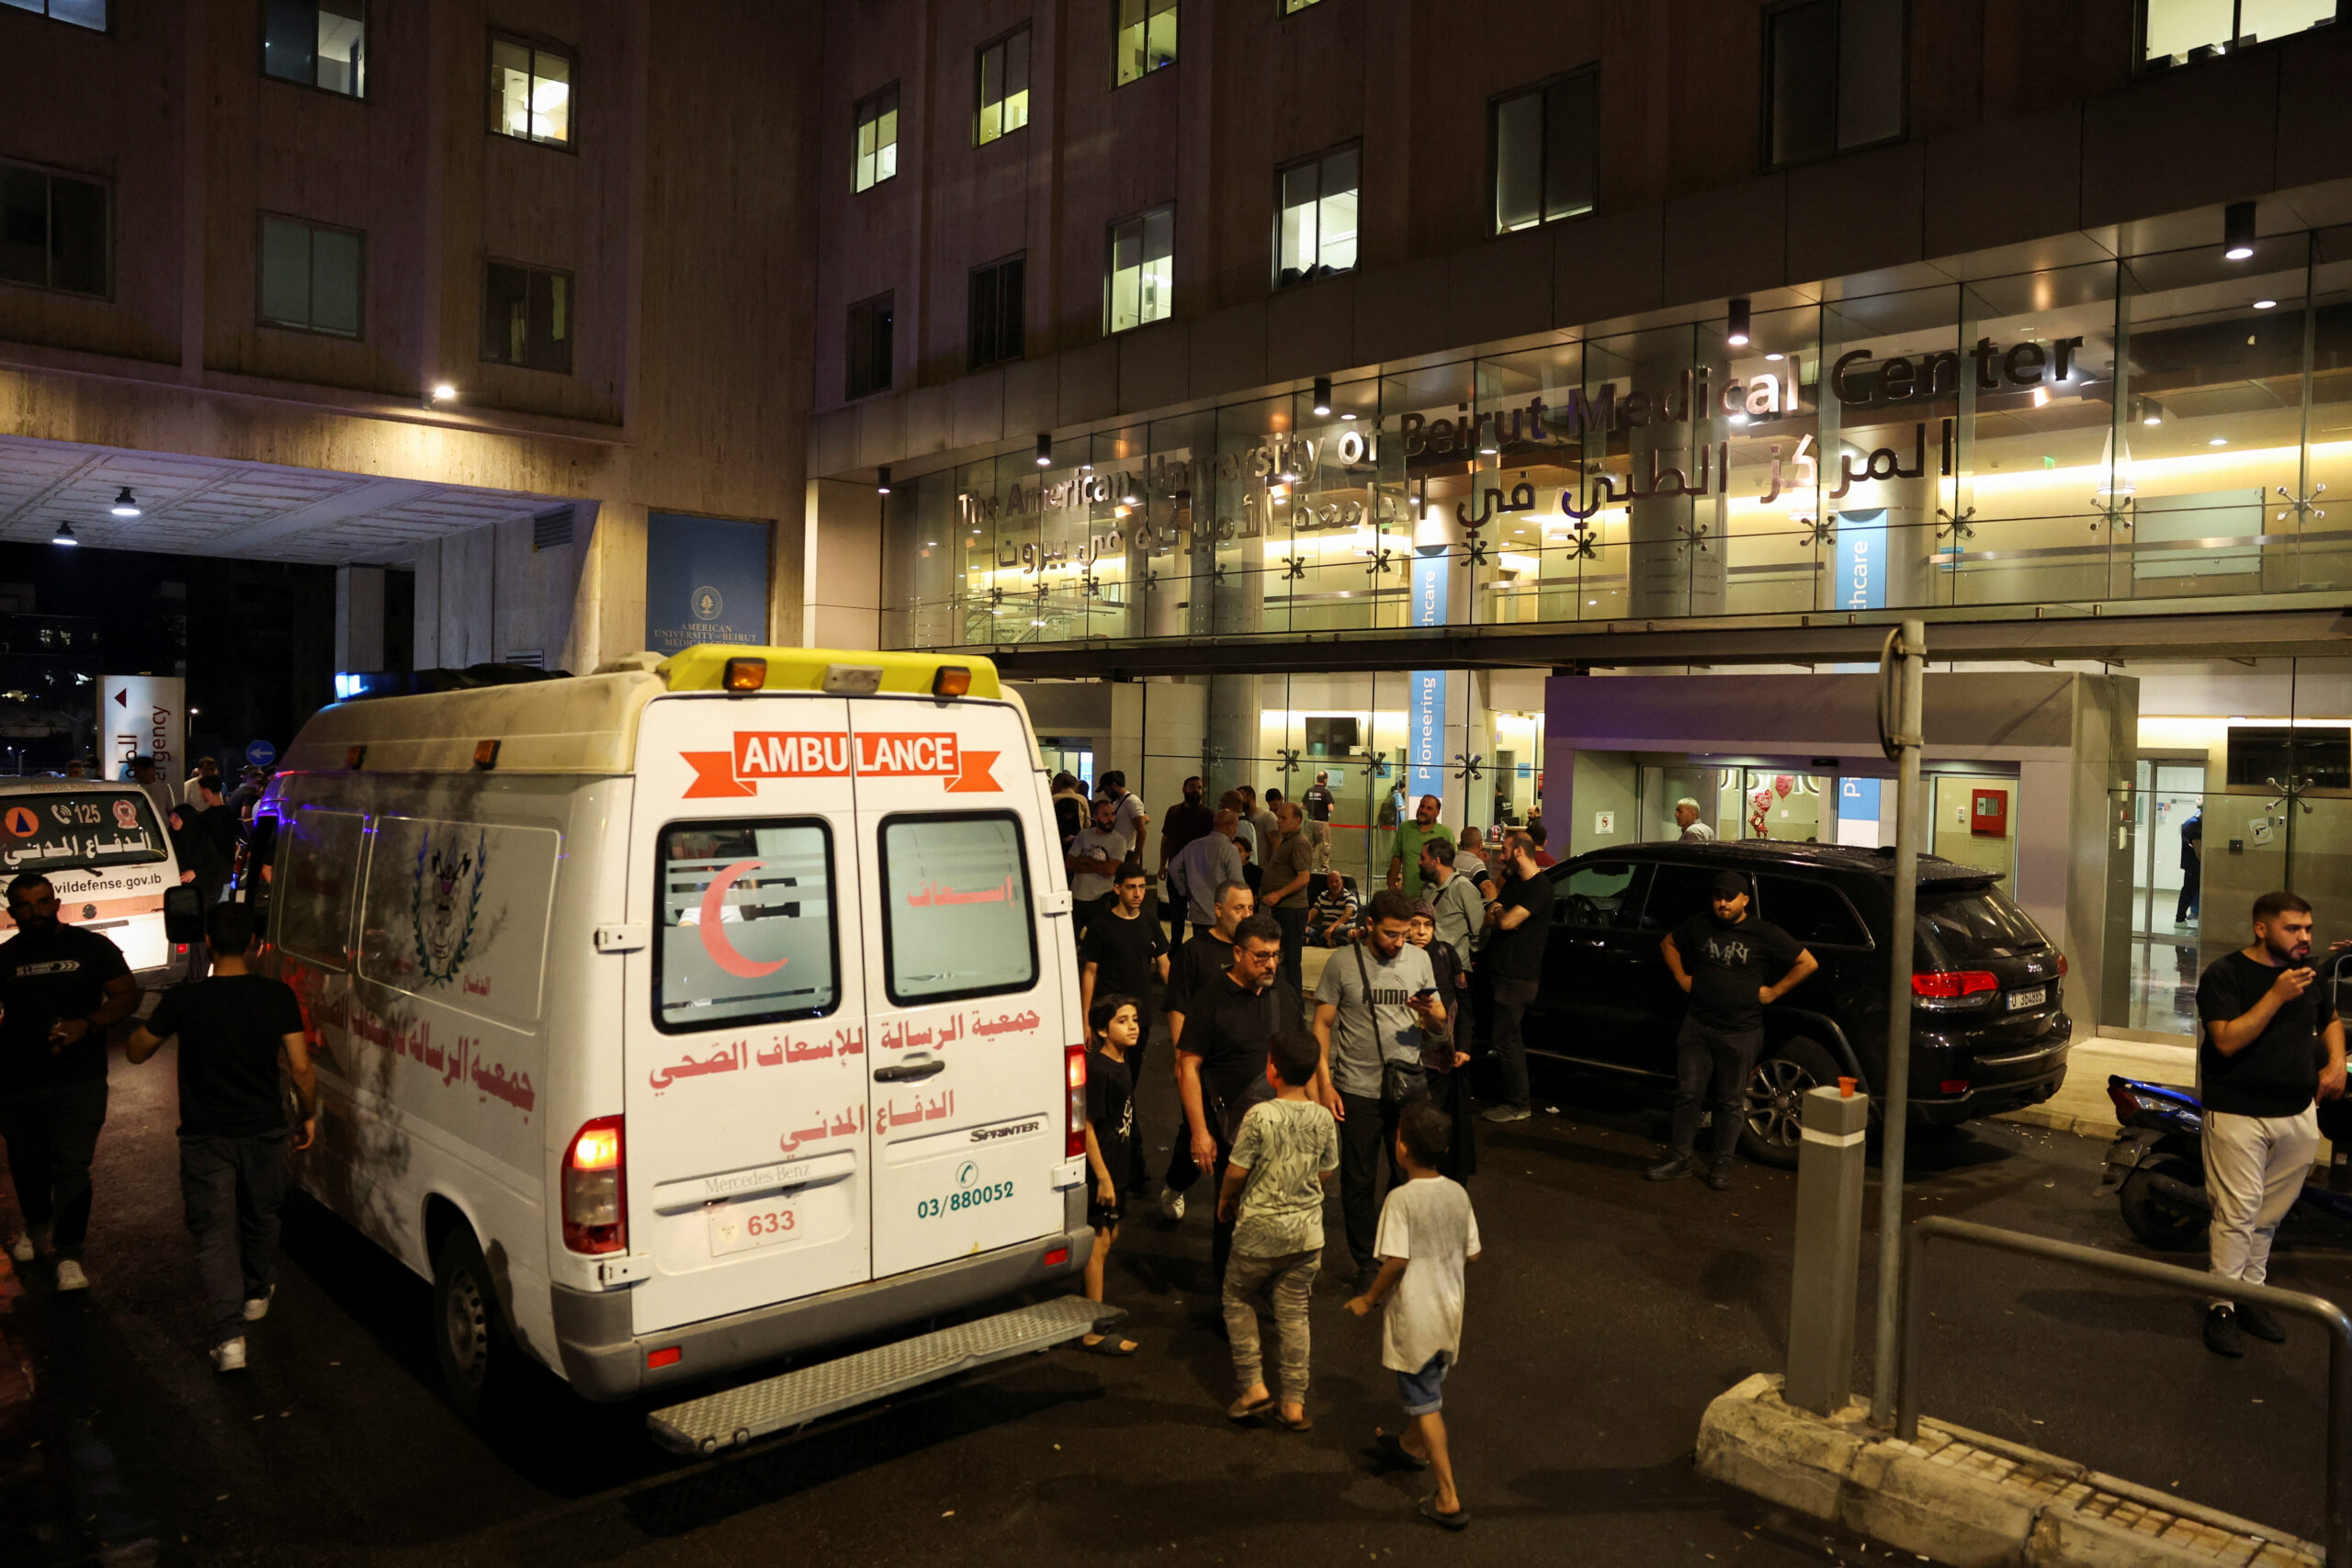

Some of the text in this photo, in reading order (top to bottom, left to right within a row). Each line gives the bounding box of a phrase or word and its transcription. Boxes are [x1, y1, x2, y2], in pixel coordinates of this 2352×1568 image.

[959, 336, 2084, 525] The American University of Beirut Medical Center
[1760, 419, 1952, 503] المركز
[1295, 474, 1429, 535] الجامعة
[1456, 470, 1535, 538] في
[1562, 441, 1727, 530] الطبي
[1075, 521, 1123, 574] في
[654, 629, 713, 640] UNIVERSITY
[723, 634, 757, 642] BEIRUT
[682, 624, 732, 632] AMERICAN
[153, 705, 171, 781] ergency
[1419, 677, 1436, 779] Pioneering
[741, 737, 955, 773] AMBULANCE
[74, 804, 101, 824] 125
[4, 831, 153, 870] الدفاع المدني
[52, 874, 162, 894] vildefense.gov.lb
[757, 1025, 864, 1068] للإسعاف
[881, 1012, 964, 1050] الرسالة
[972, 1010, 1040, 1042] جمعية
[471, 1039, 535, 1125] جمعية
[780, 1089, 954, 1159] الدفاع المدني
[918, 1181, 1014, 1219] 03/880052
[748, 1210, 795, 1236] 633
